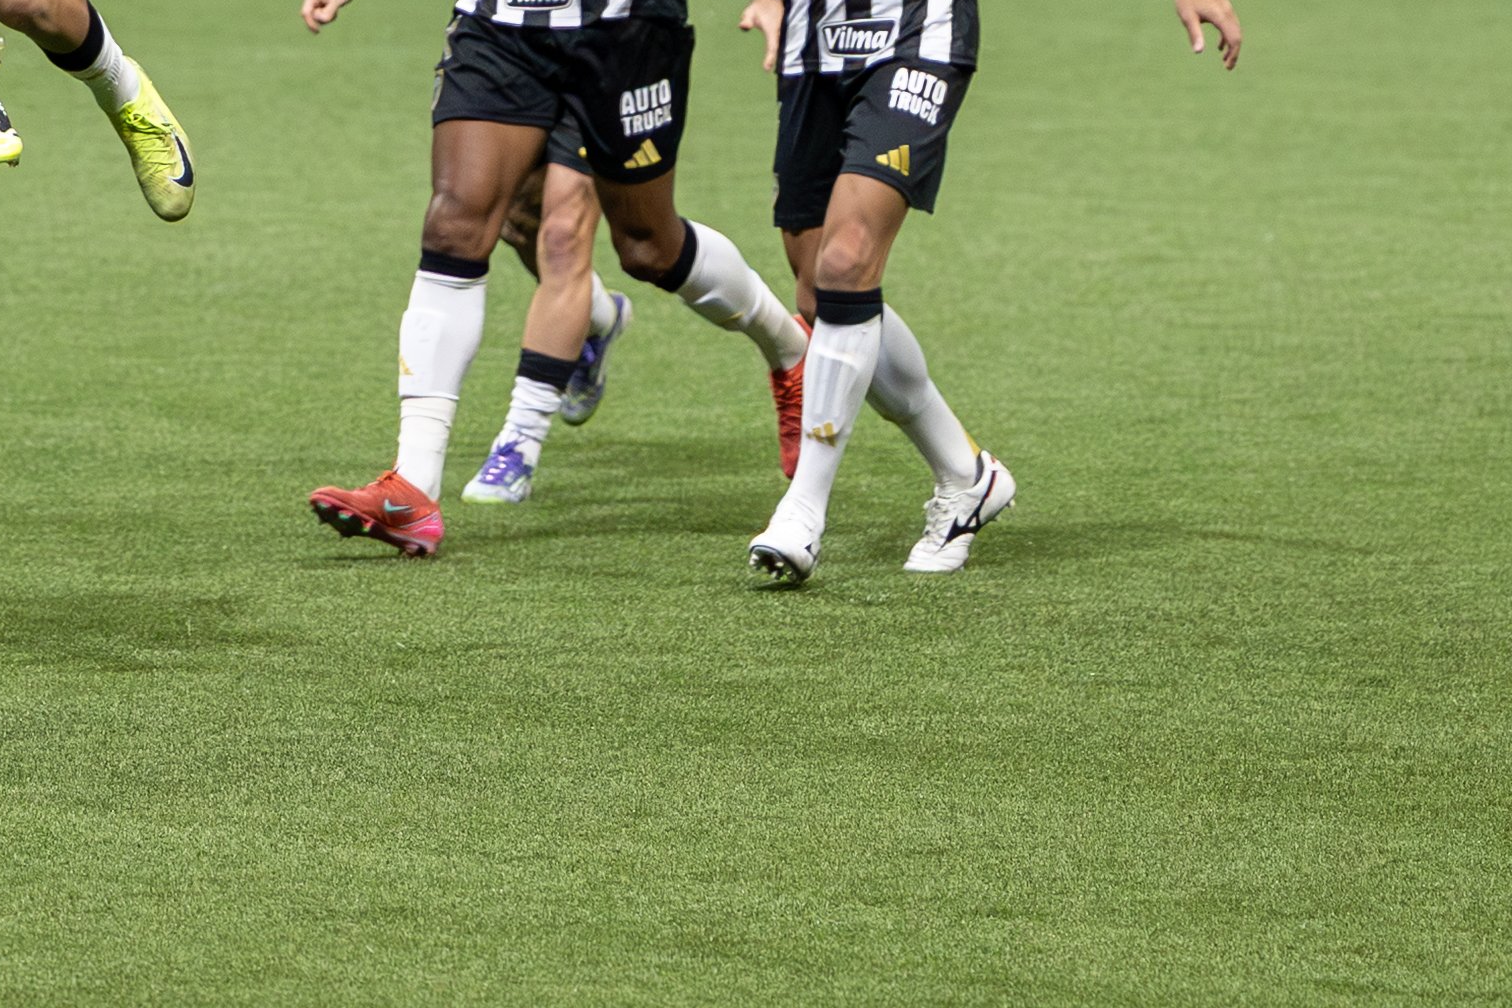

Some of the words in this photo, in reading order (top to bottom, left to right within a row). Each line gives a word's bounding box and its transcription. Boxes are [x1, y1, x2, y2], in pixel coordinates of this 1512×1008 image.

[824, 25, 889, 50] Vilma
[620, 78, 672, 116] AUTO
[891, 67, 948, 105] AUTO
[620, 104, 672, 137] TRUCK
[888, 89, 941, 126] TRUCK
